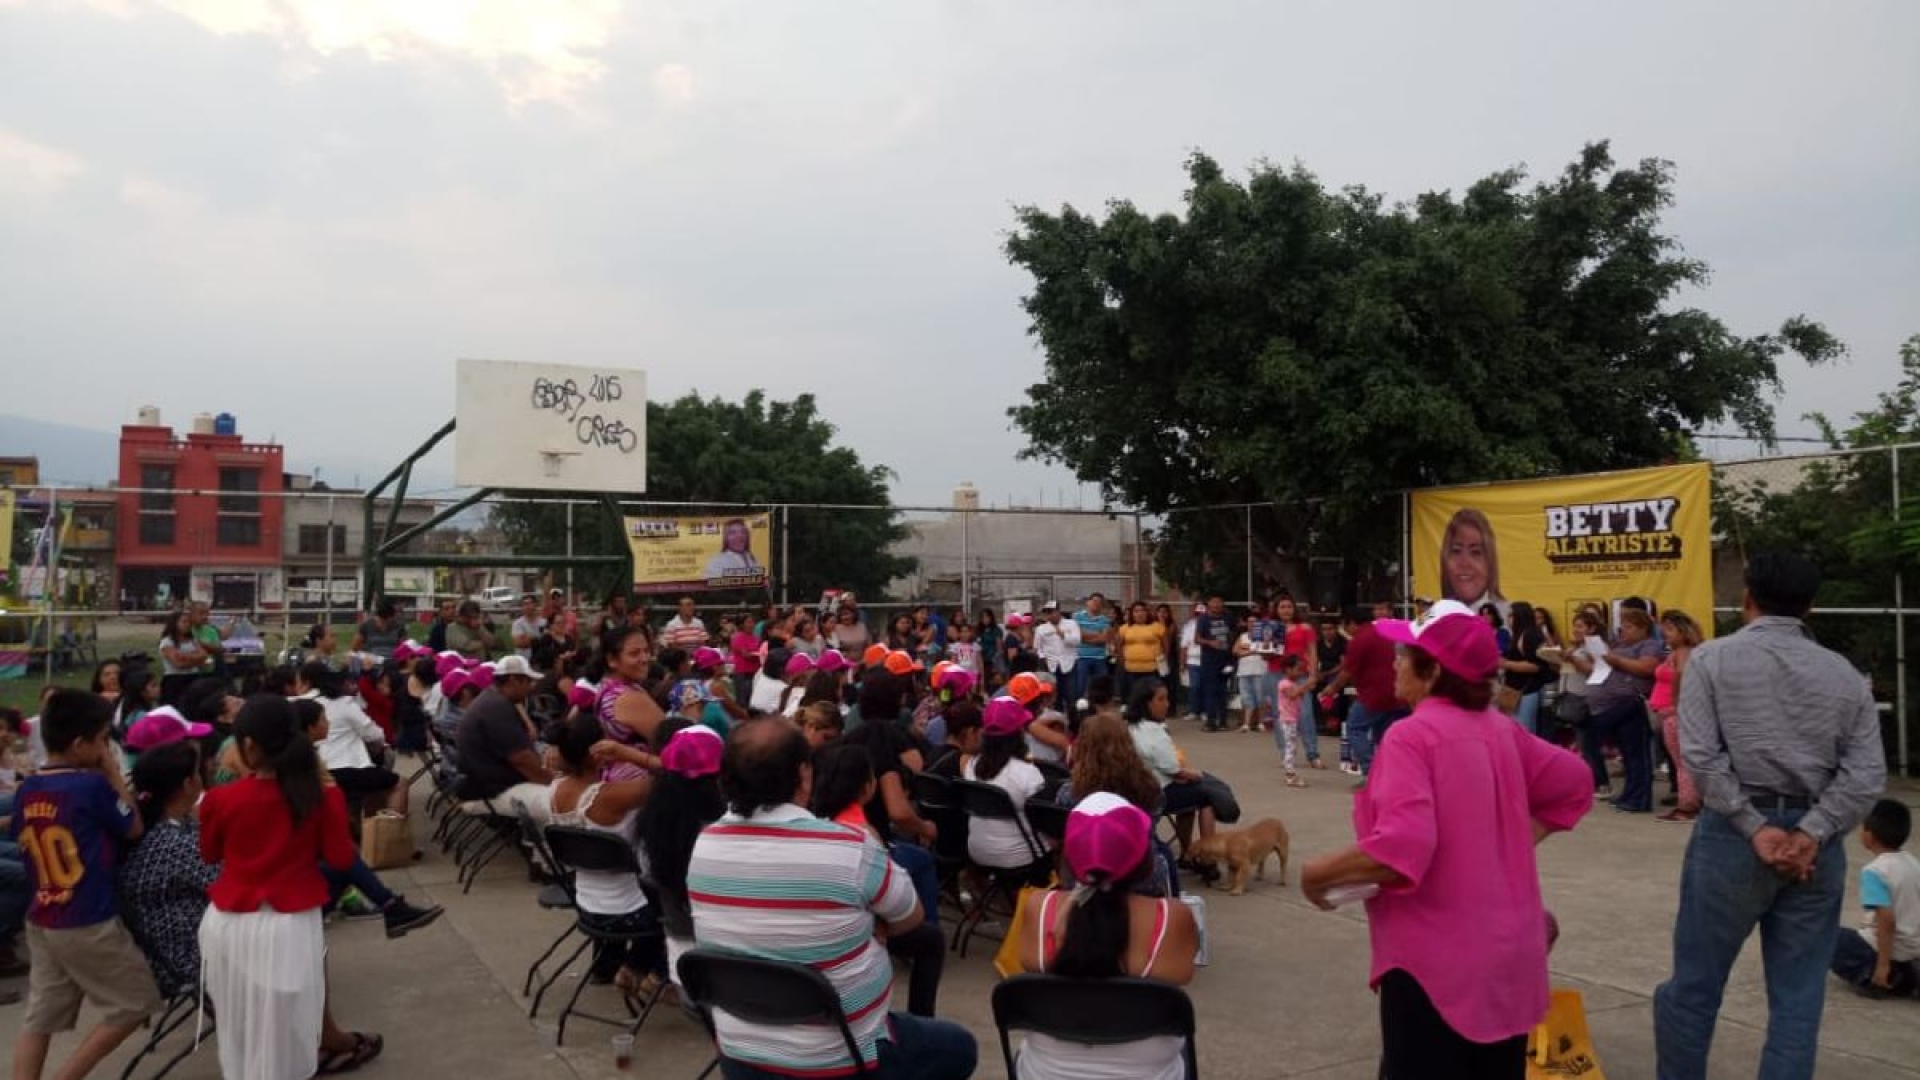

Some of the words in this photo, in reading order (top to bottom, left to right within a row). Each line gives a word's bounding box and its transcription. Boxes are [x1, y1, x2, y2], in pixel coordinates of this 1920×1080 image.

[1545, 498, 1677, 537] BETTY
[1546, 531, 1674, 556] ALATRISTE
[18, 824, 85, 889] 10
